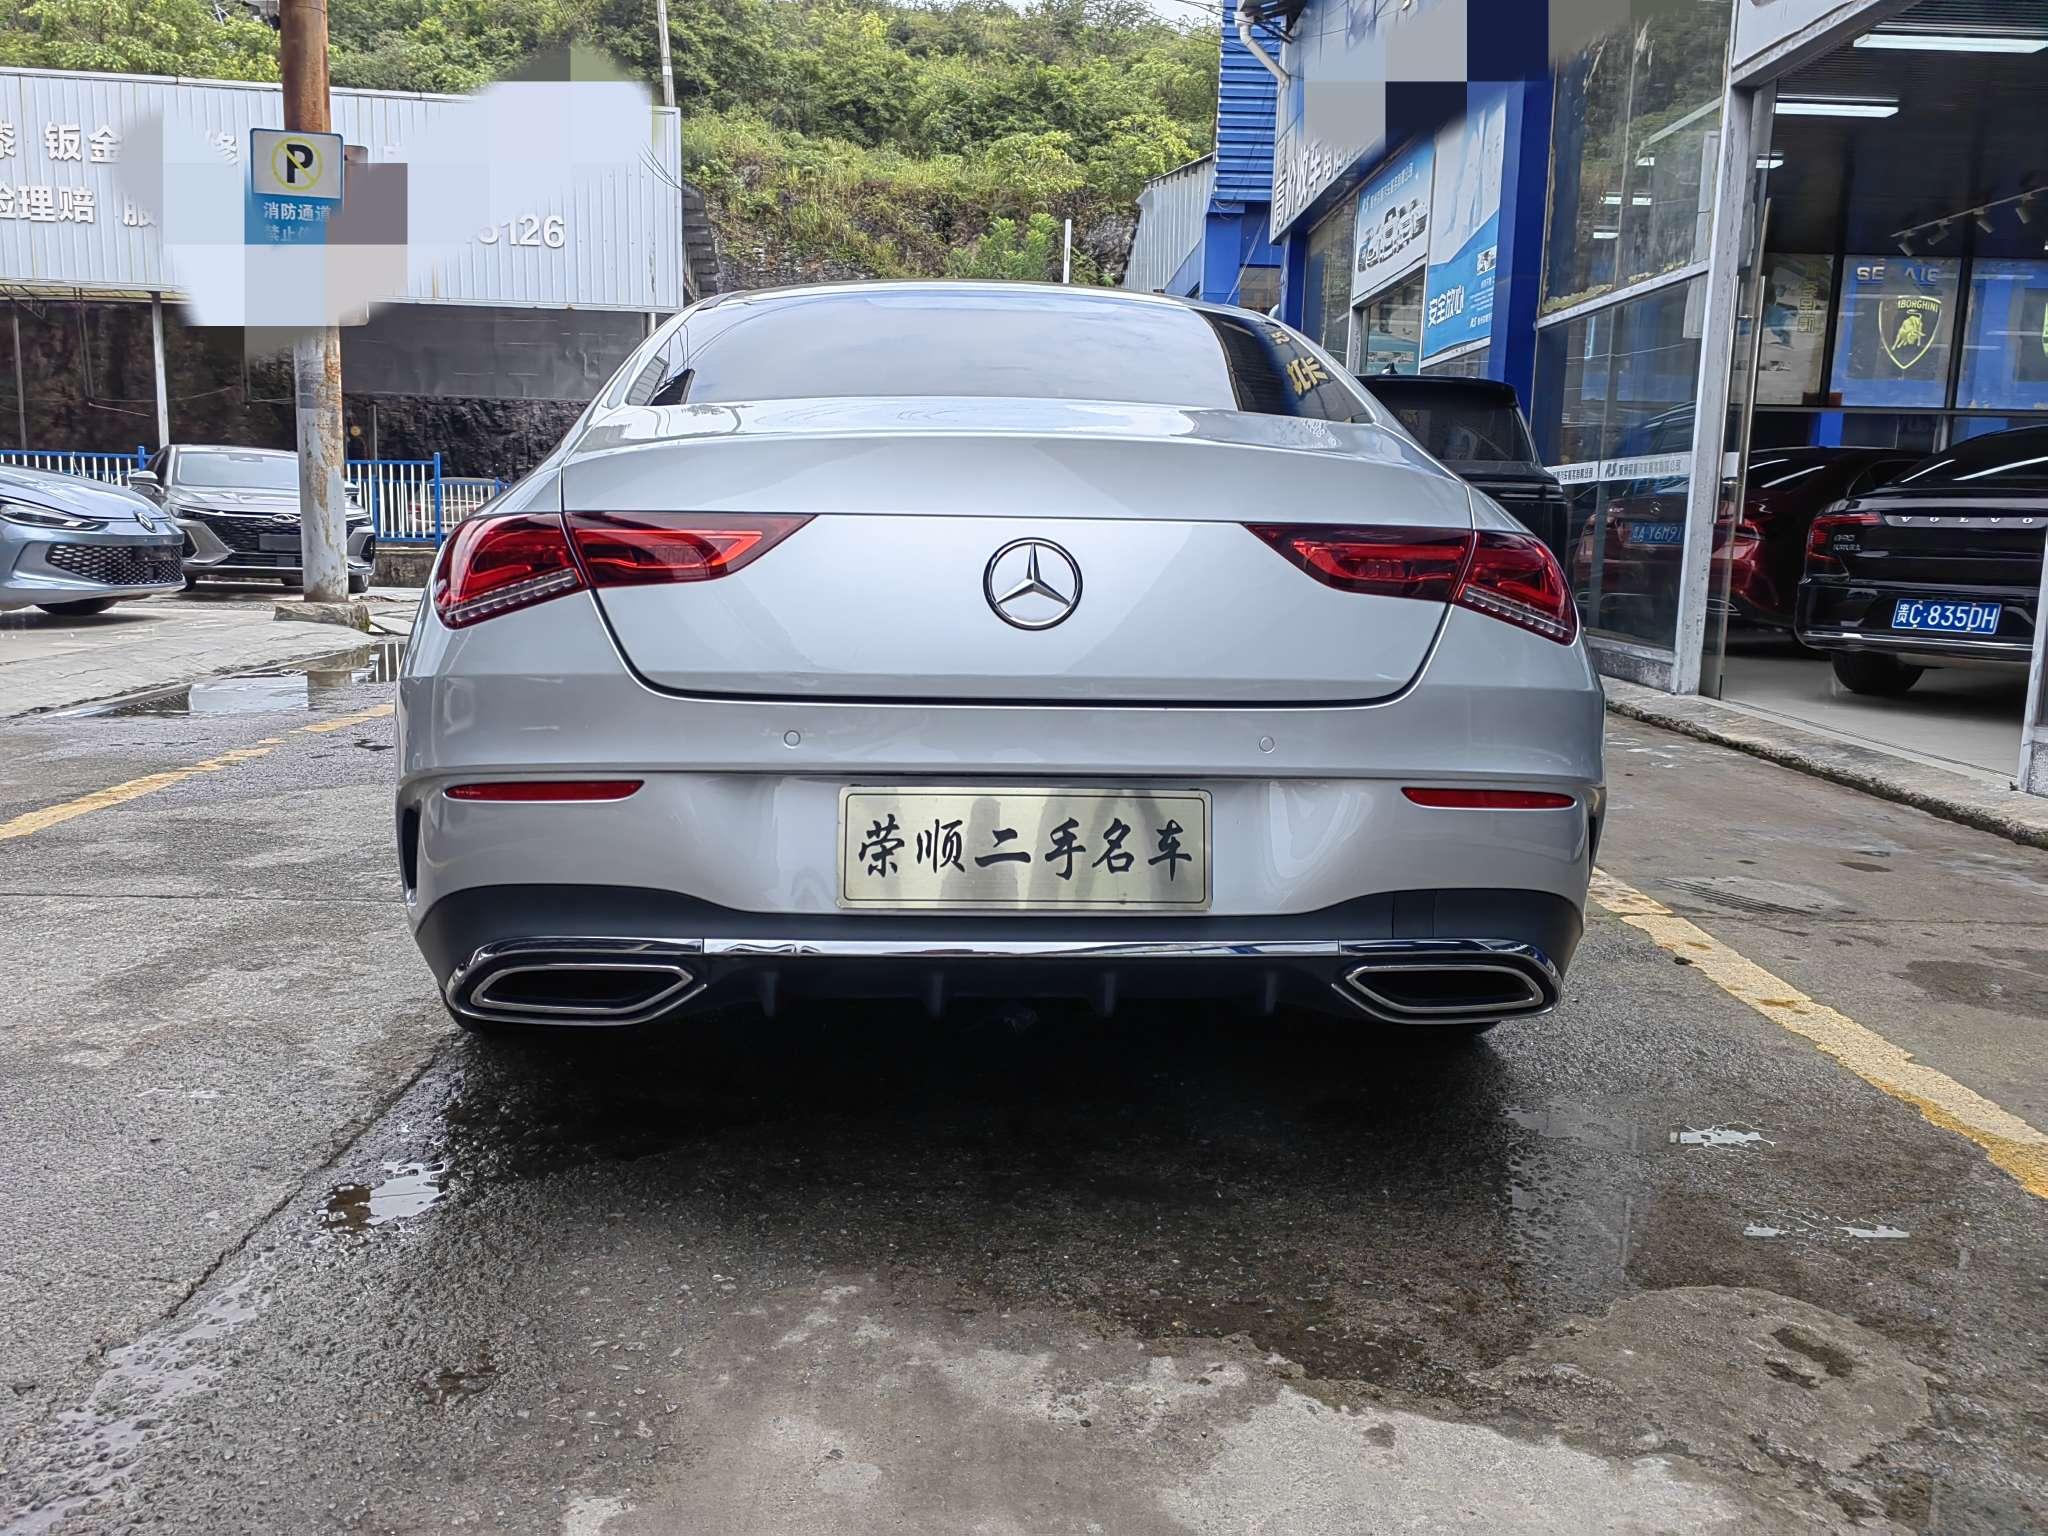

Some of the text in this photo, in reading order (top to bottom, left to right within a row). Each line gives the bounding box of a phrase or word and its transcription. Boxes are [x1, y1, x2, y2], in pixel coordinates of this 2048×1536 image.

[45, 121, 123, 163] 钣金
[1901, 516, 2034, 524] VOLVO
[858, 813, 1193, 882] 荣顺二手名车
